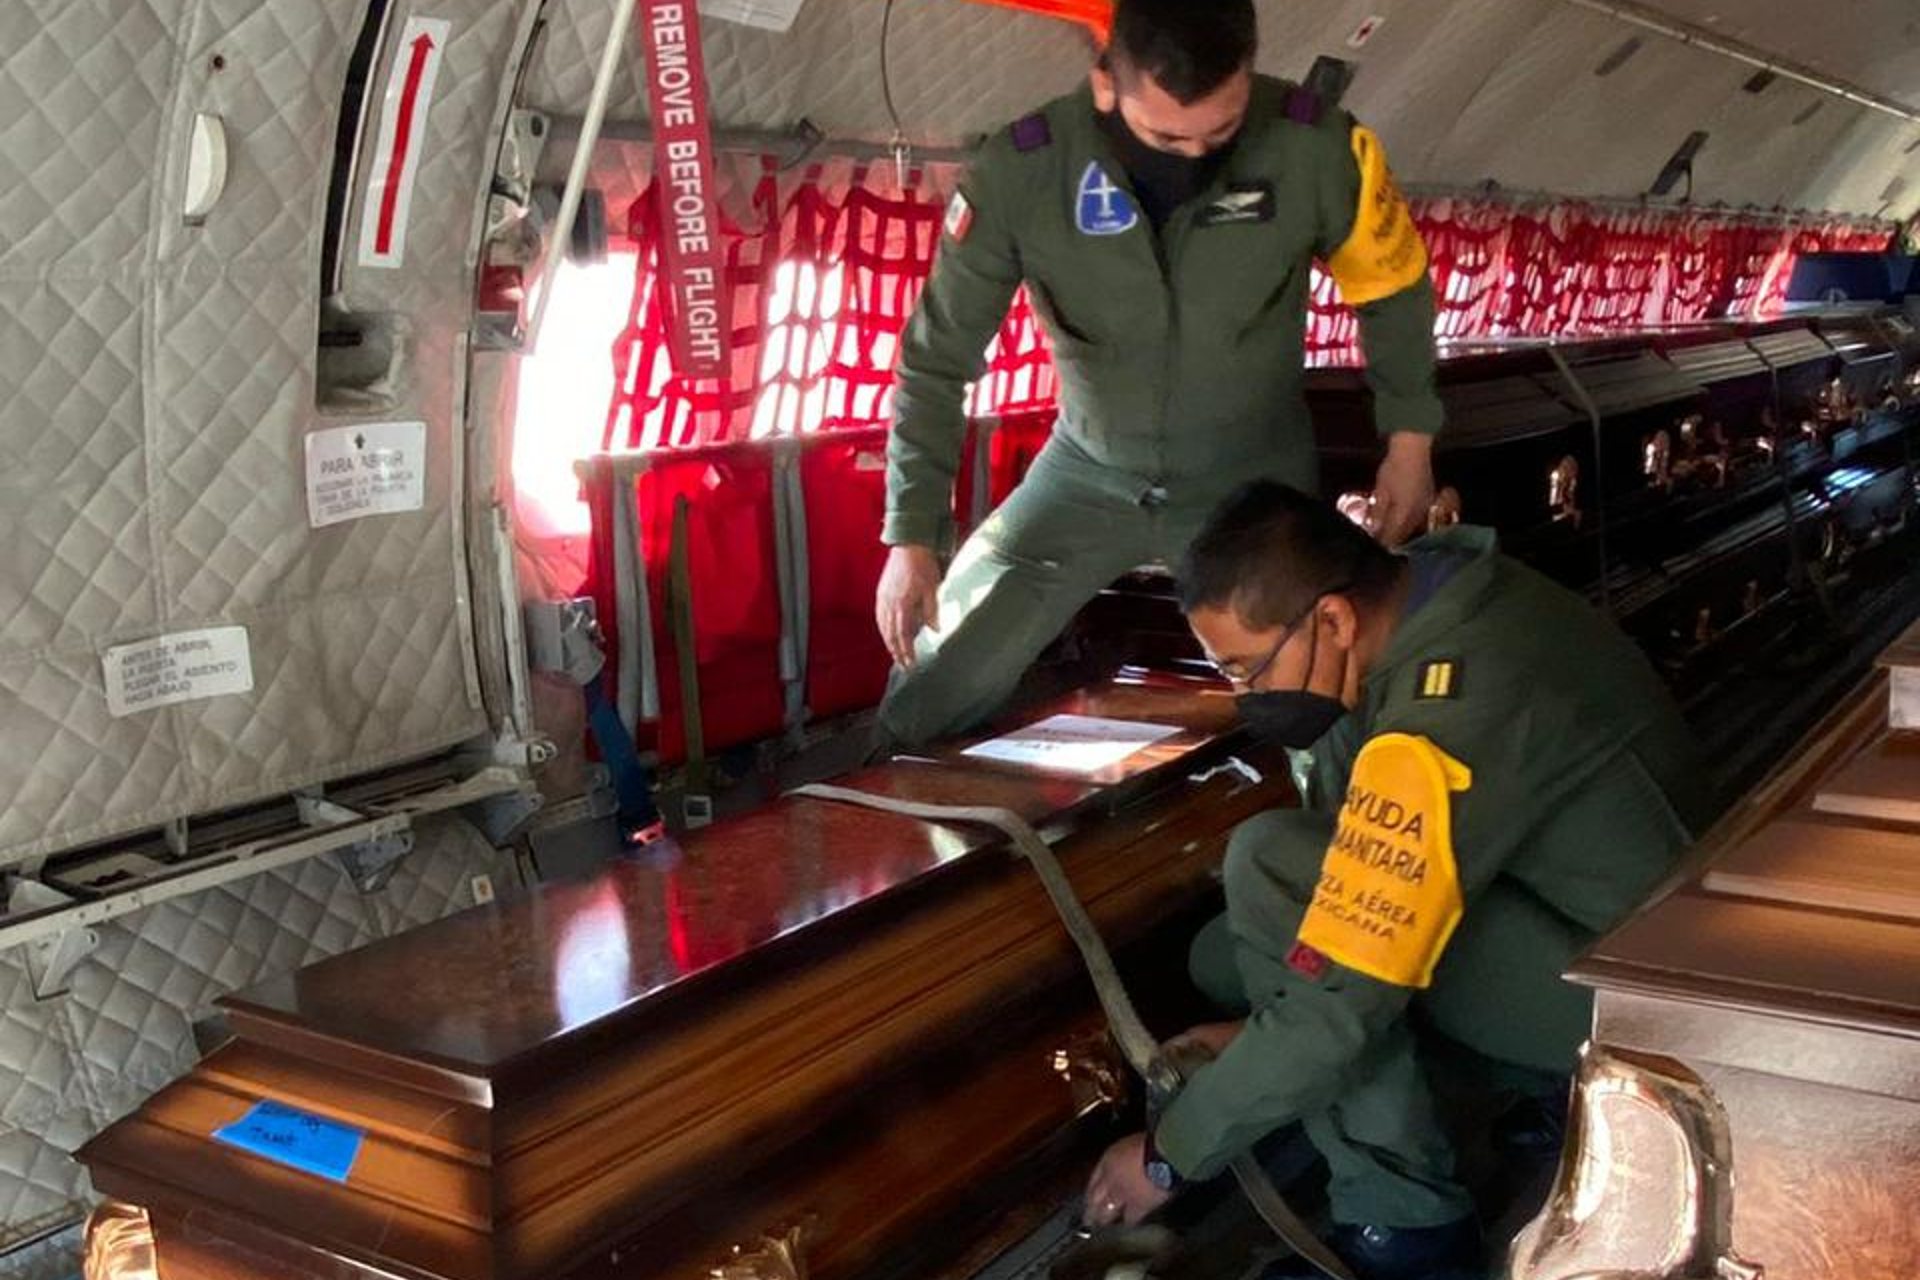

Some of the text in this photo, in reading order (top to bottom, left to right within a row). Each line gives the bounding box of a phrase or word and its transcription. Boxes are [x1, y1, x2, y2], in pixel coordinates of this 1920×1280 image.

[652, 3, 722, 362] REMOVE BEFORE FLIGHT
[1346, 787, 1424, 842] AYUDA
